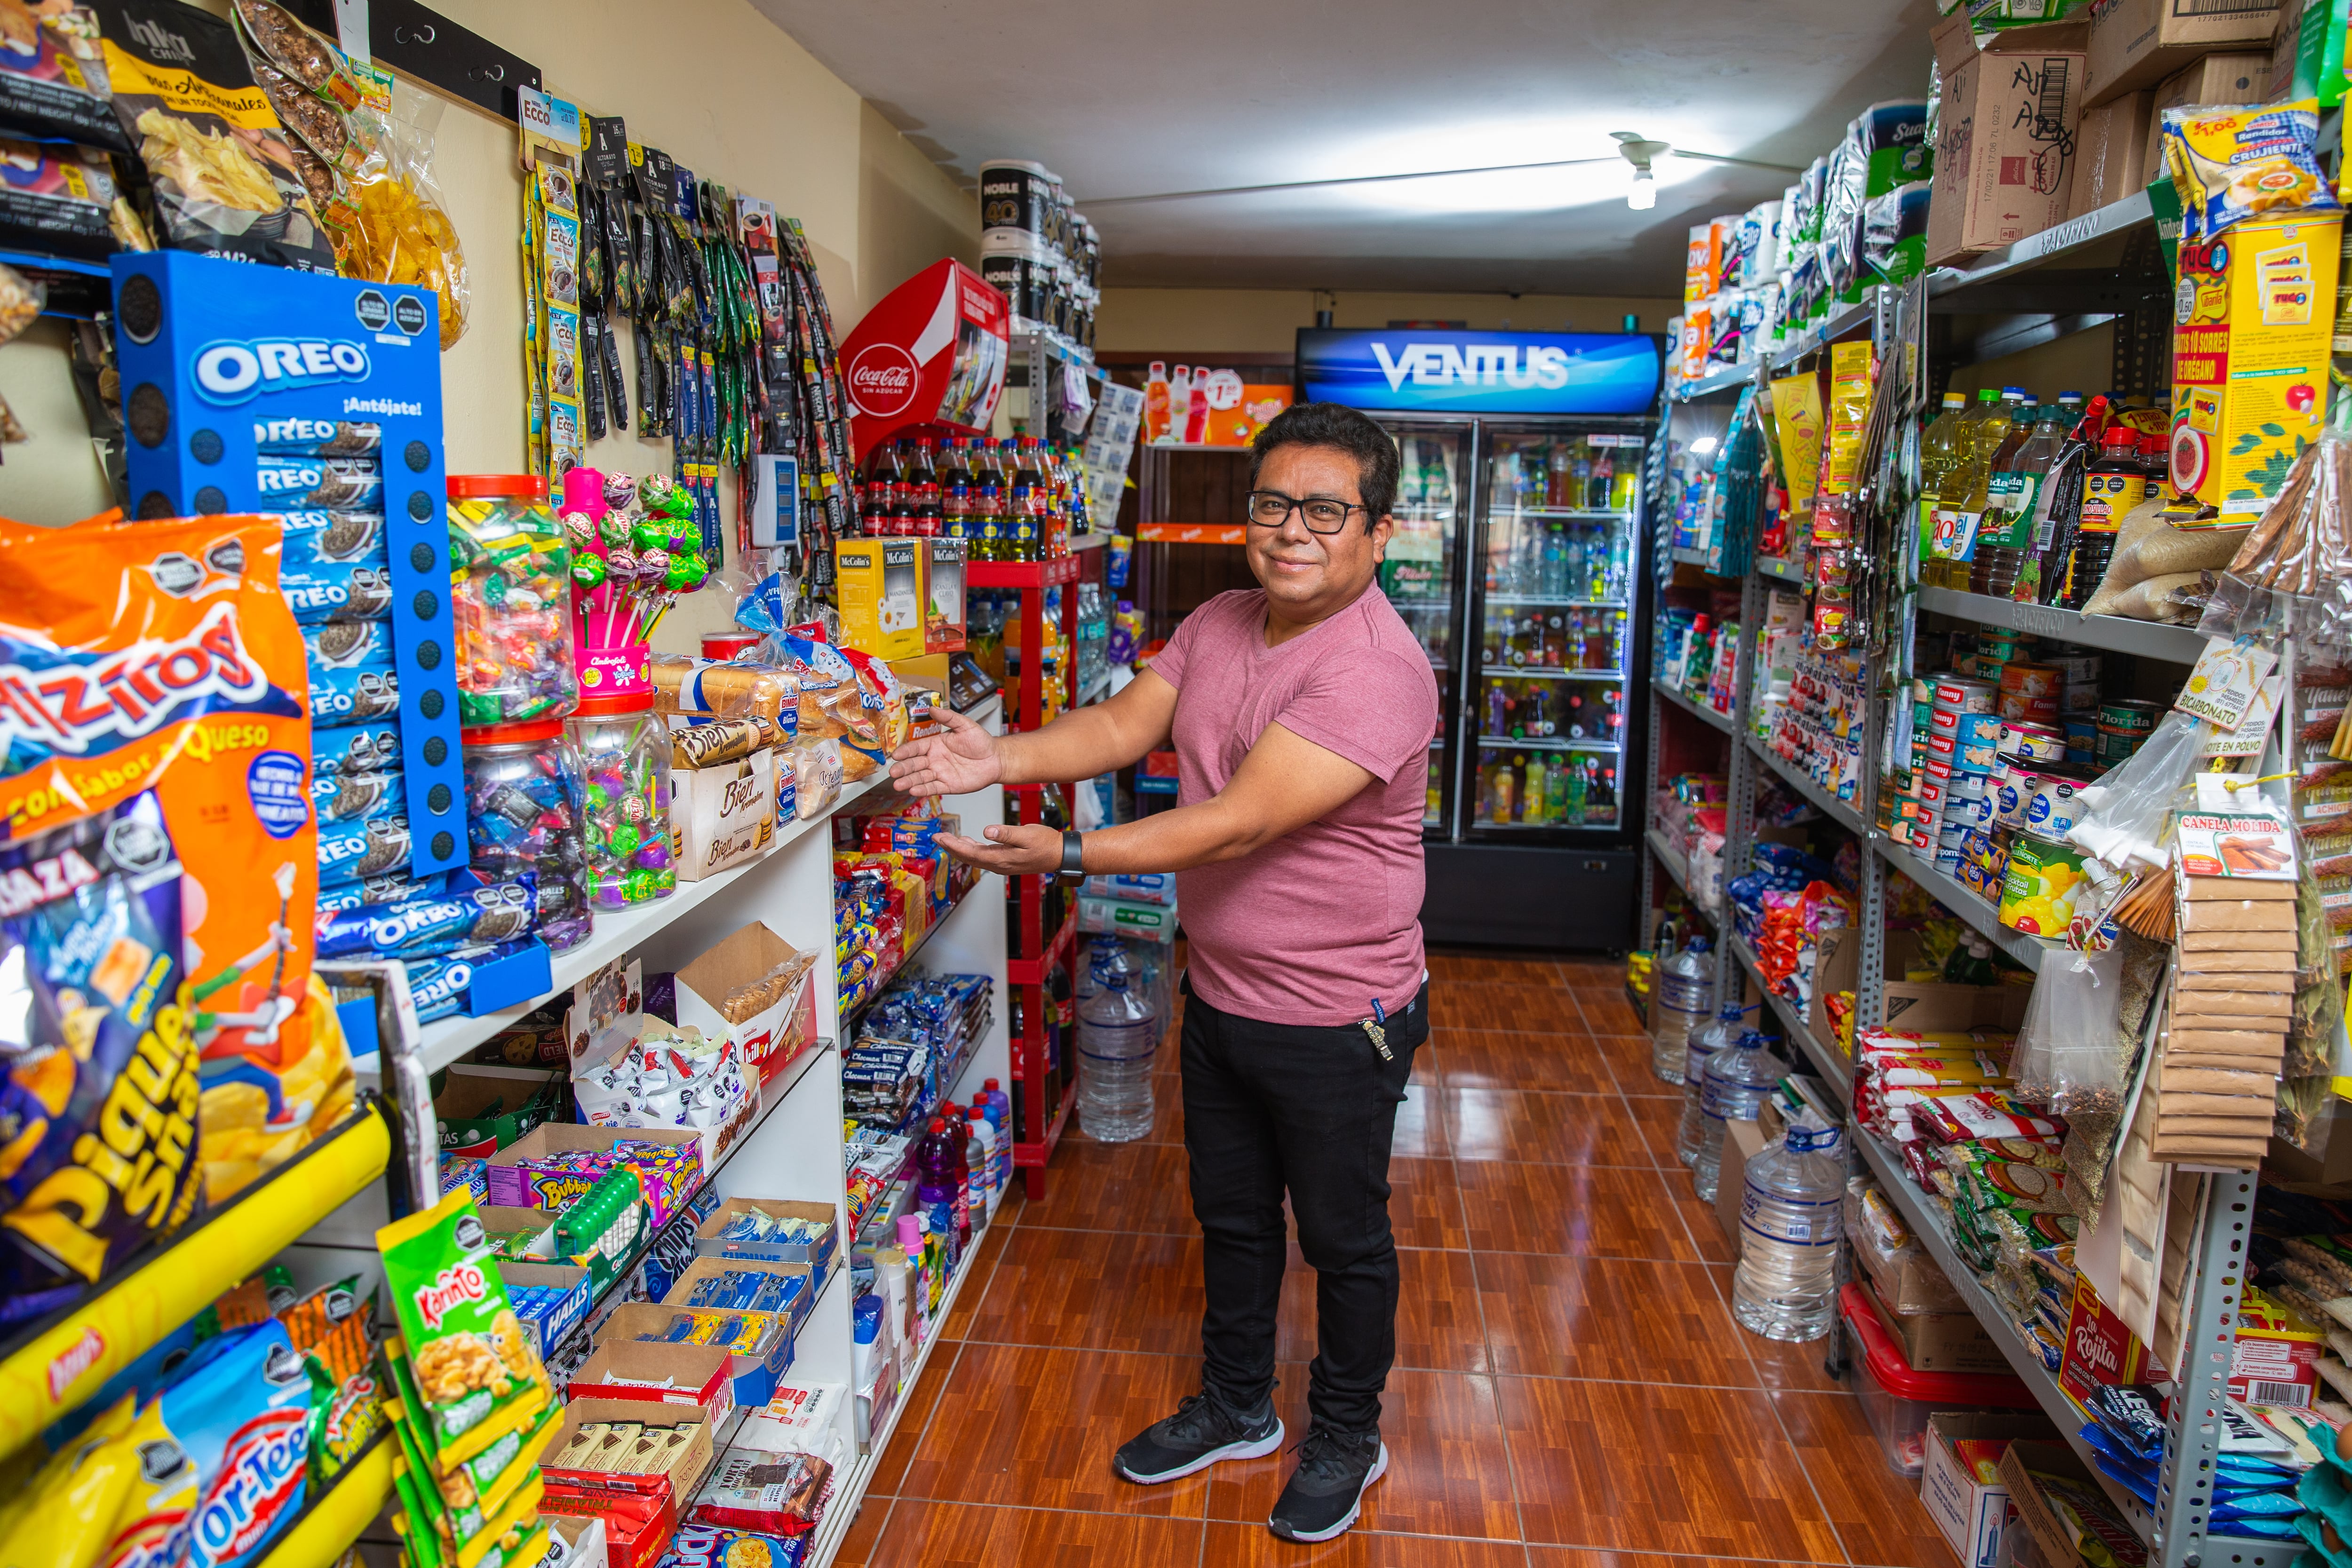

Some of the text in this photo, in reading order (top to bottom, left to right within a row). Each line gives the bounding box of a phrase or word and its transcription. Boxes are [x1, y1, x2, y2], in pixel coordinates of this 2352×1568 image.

[524, 100, 550, 126] ECCO
[1992, 104, 2001, 125] 0232
[2238, 127, 2287, 142] Rendidor
[596, 153, 617, 162] ALTOMAYO
[1988, 142, 1997, 165] 17:06
[644, 175, 668, 191] ALTOMAYO
[984, 183, 1019, 195] NOBLE
[1984, 167, 1995, 203] 17/02/21
[2173, 332, 2190, 354] GRATIS
[2190, 330, 2198, 353] 10
[2199, 331, 2228, 354] SOBRES
[197, 342, 367, 393] OREO
[853, 366, 910, 387] Coca-Cola
[1370, 342, 1569, 393] VENTUS
[2177, 361, 2184, 381] DE
[2184, 355, 2215, 381] ORÉGANO
[343, 397, 422, 415] ¡Antójate!
[2135, 409, 2161, 422] LITRO
[258, 470, 321, 492] REO
[841, 557, 870, 566] McColin's
[886, 550, 914, 565] McColin's
[933, 549, 959, 562] McColin's
[284, 585, 348, 609] REO
[590, 656, 627, 666] Ambrosoli
[781, 696, 798, 709] BIMBO
[1938, 687, 1961, 700] Fanny
[2220, 693, 2245, 706] 945640352
[2225, 688, 2246, 700] PEDIDOS:
[1932, 711, 1954, 725] Fanny
[2099, 710, 2151, 728] Florida
[2179, 695, 2237, 725] BICARBONATO
[782, 716, 796, 724] Blanco
[181, 722, 270, 763] Queso
[1930, 737, 1951, 751] Fanny
[2222, 740, 2262, 752] EN POLVO
[1926, 761, 1950, 776] Fanny
[781, 776, 796, 789] BIMBO
[720, 778, 755, 819] Bien
[782, 792, 795, 804] Blanco
[2182, 816, 2282, 834] CANELA MOLIDA
[2006, 874, 2029, 889] Cocktail
[745, 1042, 769, 1064] killos
[852, 1053, 881, 1062] Chocman
[843, 1071, 873, 1081] Chocman
[438, 1131, 459, 1145] TAS
[414, 1265, 485, 1331] Karinto
[2082, 1289, 2096, 1306] Maggi
[546, 1280, 588, 1342] HALLS
[2086, 1313, 2098, 1334] La
[770, 1333, 790, 1366] SUBLIME
[2074, 1325, 2118, 1372] Rojita
[2070, 1360, 2090, 1380] HECHO CON
[676, 1445, 707, 1490] PRINCESA
[718, 1459, 746, 1490] TORTA
[729, 1459, 752, 1490] CHOCOLATE
[788, 1541, 797, 1552] 140
